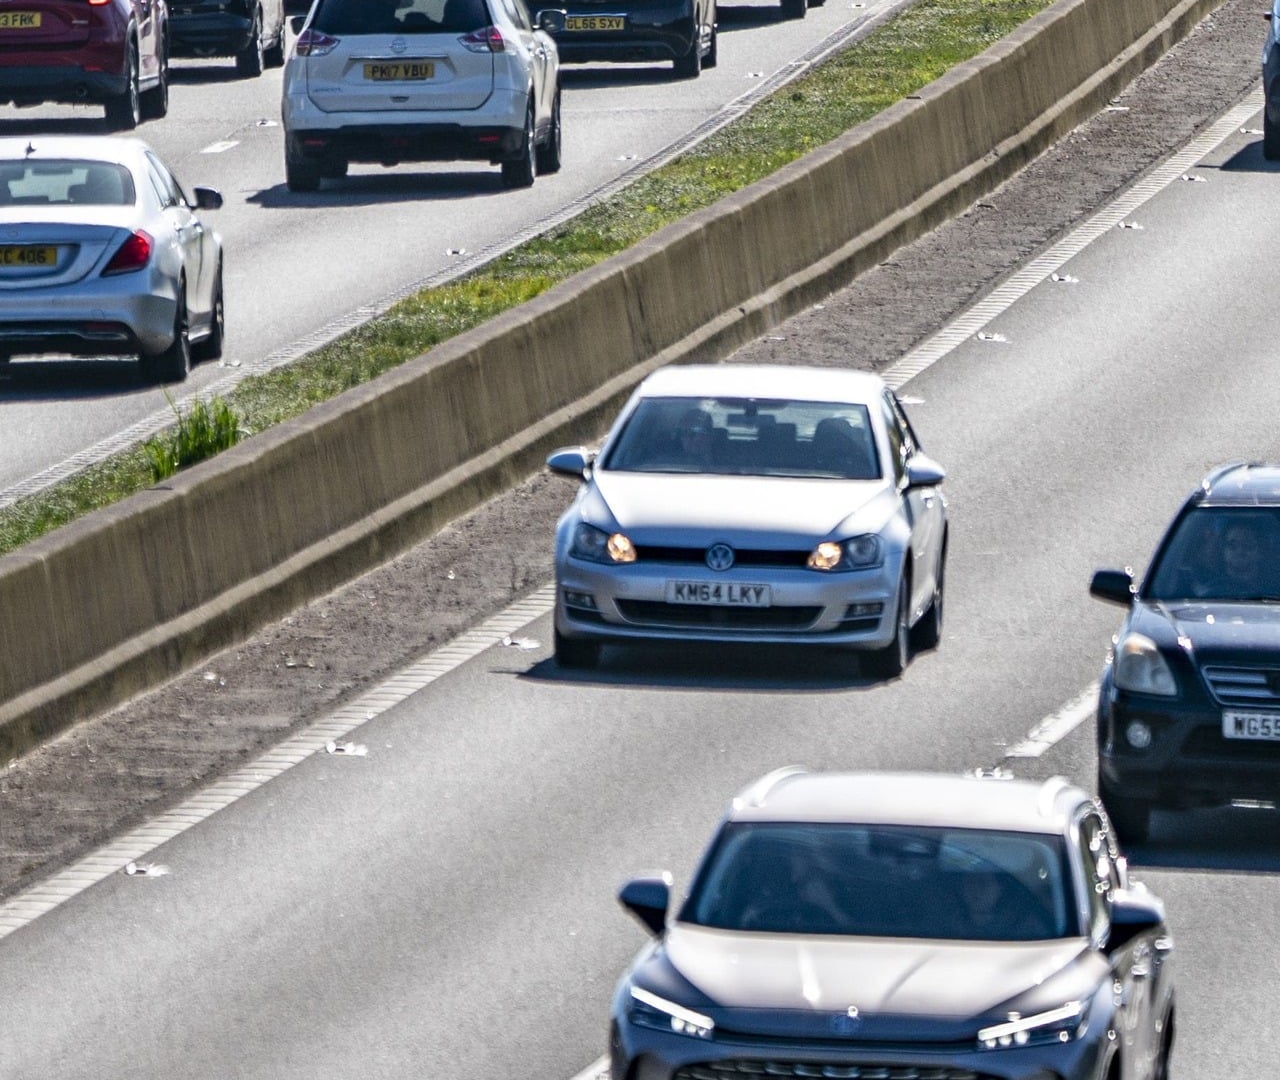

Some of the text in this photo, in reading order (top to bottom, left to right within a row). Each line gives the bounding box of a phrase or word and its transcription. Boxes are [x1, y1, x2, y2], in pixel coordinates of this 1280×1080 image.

[12, 14, 35, 25] FRK
[17, 249, 46, 264] 406
[674, 582, 763, 603] KM64 LKY
